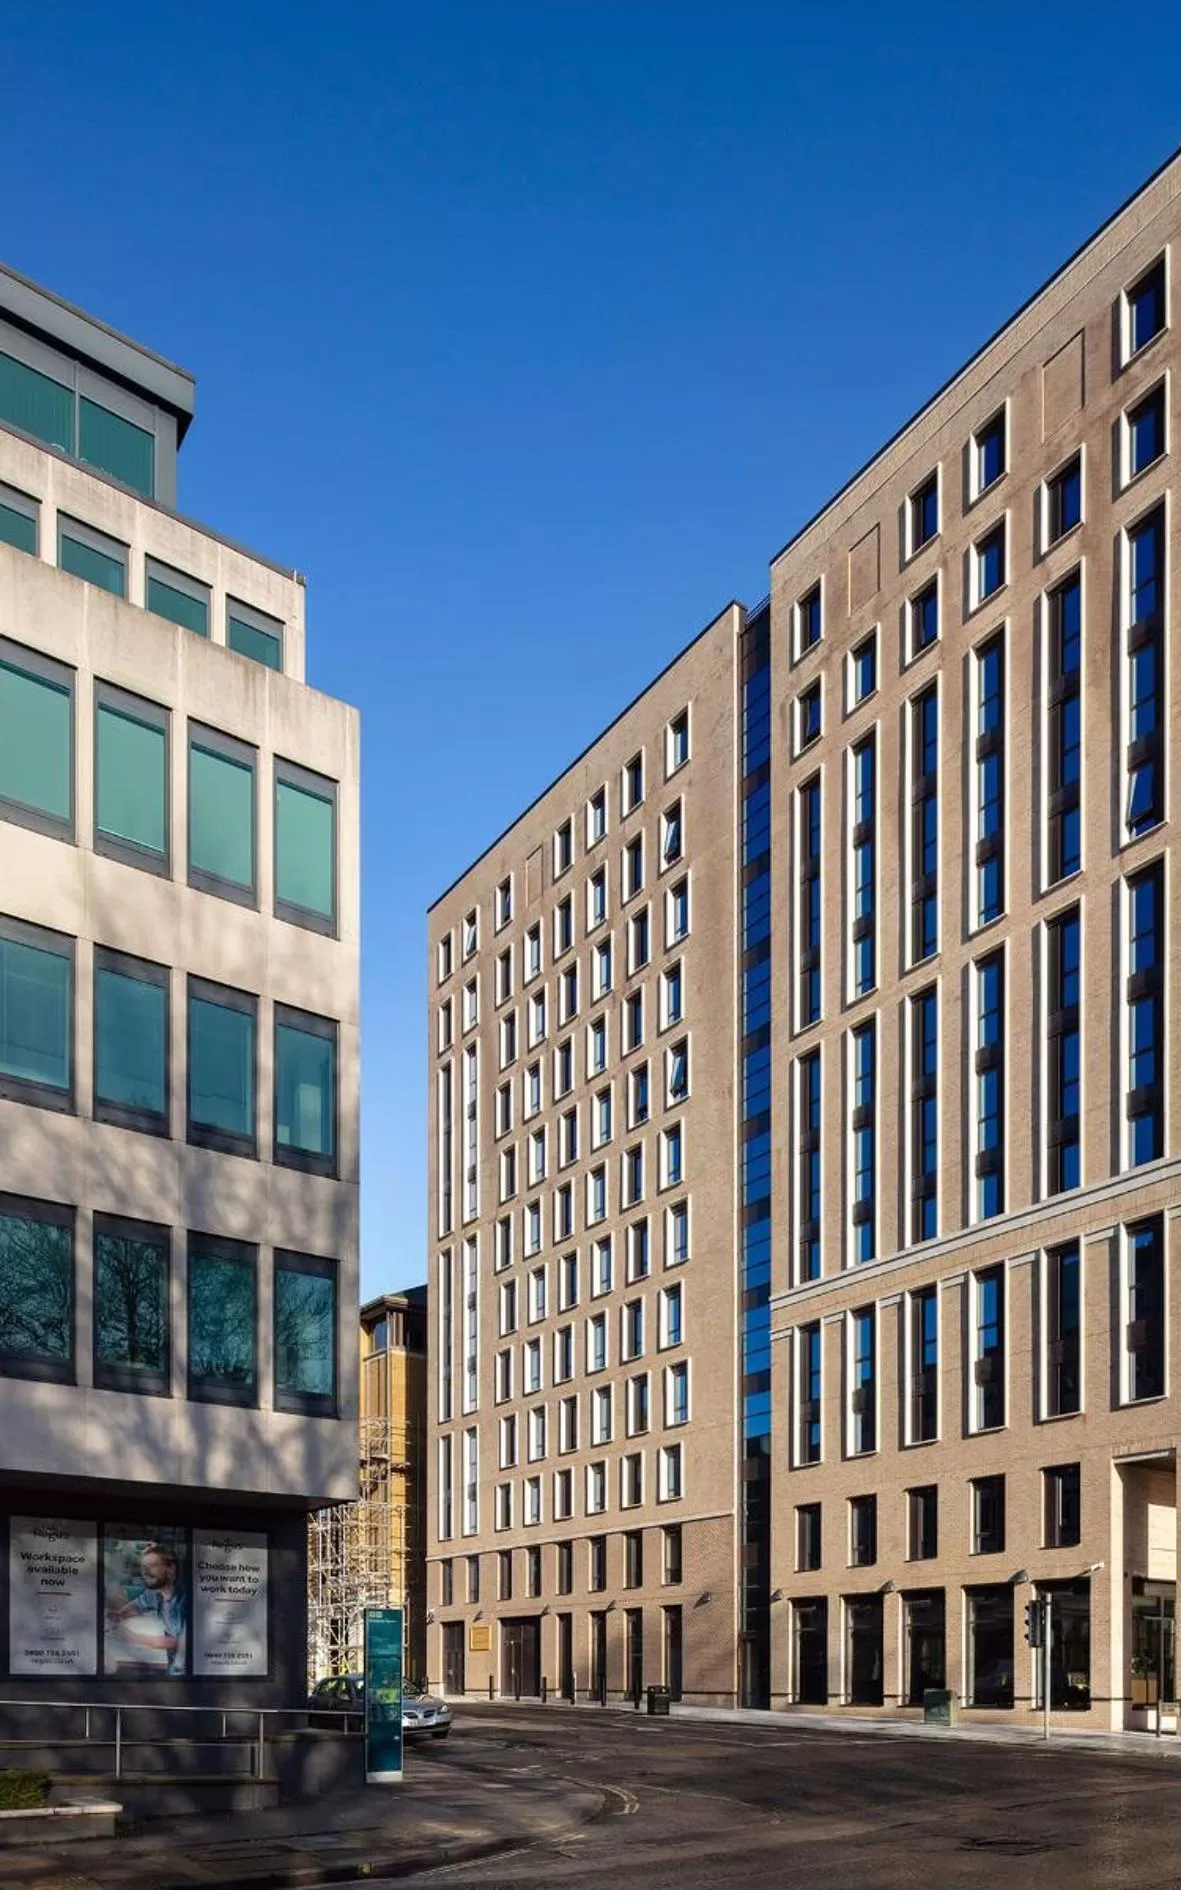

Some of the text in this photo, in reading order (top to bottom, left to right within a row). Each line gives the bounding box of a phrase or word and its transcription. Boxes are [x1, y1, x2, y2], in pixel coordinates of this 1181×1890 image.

[20, 1551, 86, 1564] Workspace
[26, 1565, 79, 1576] available
[198, 1561, 261, 1573] Choose how
[40, 1579, 66, 1587] now
[200, 1574, 260, 1584] you want to
[201, 1585, 258, 1597] work today
